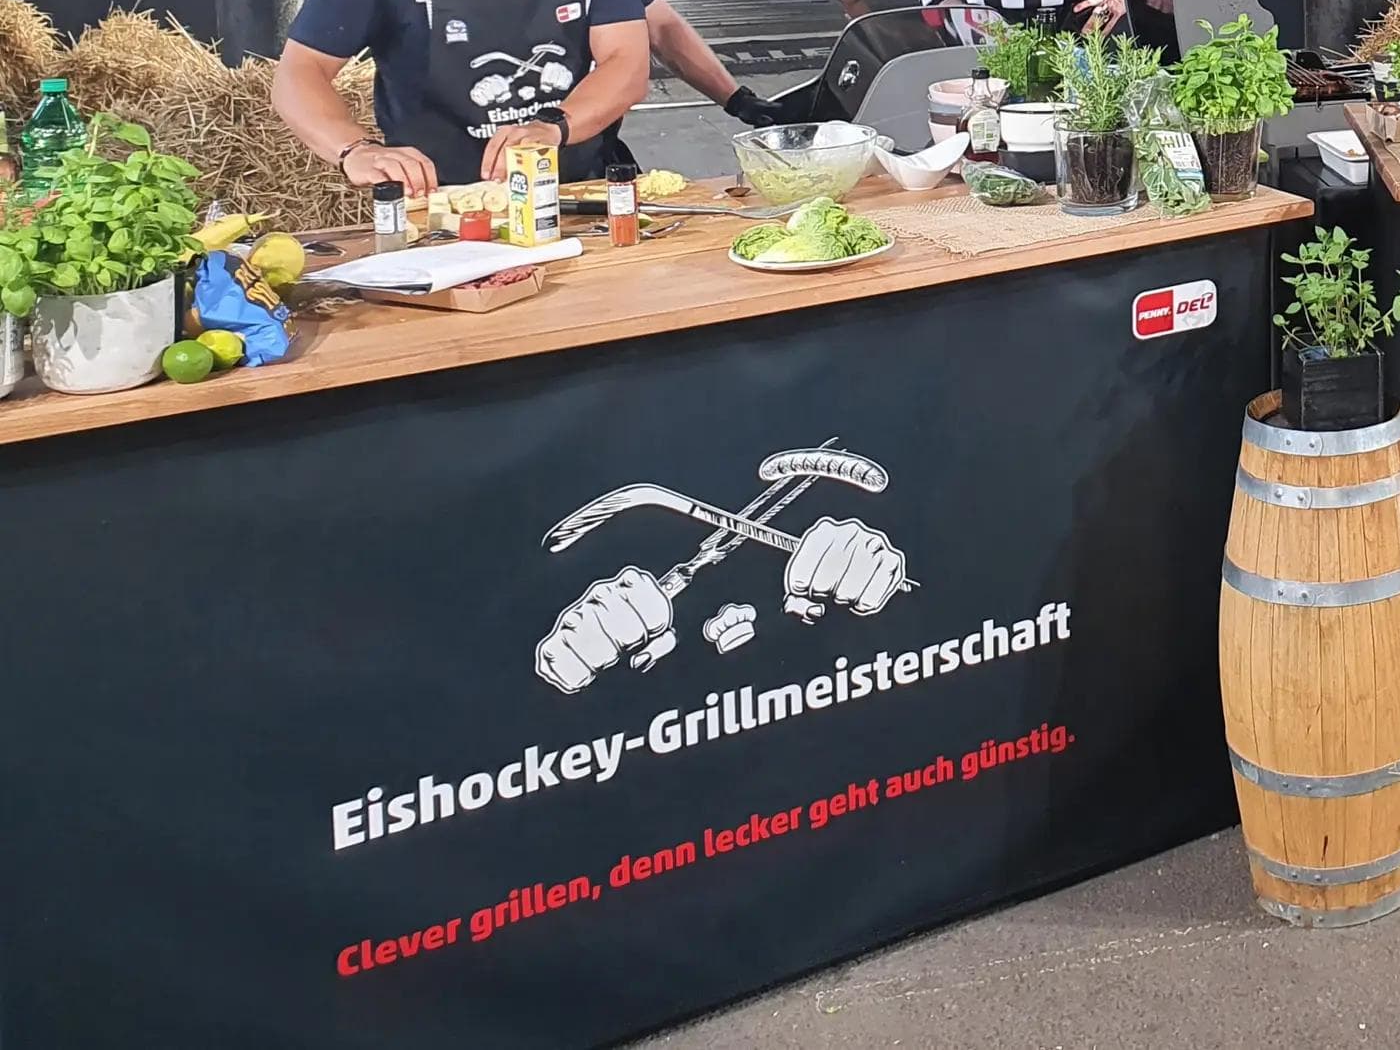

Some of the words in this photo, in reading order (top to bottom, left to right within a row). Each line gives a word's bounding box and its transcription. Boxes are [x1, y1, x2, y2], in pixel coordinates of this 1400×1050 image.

[1176, 292, 1214, 315] DEL
[332, 601, 1071, 850] Eishockey-Grillmeisterschaft
[336, 917, 462, 977] Clever
[469, 875, 602, 943] grillen,
[609, 841, 697, 890] denn
[703, 805, 802, 858] lecker
[808, 778, 880, 830] geht
[885, 755, 955, 799] auch
[960, 722, 1076, 782] günstig.
